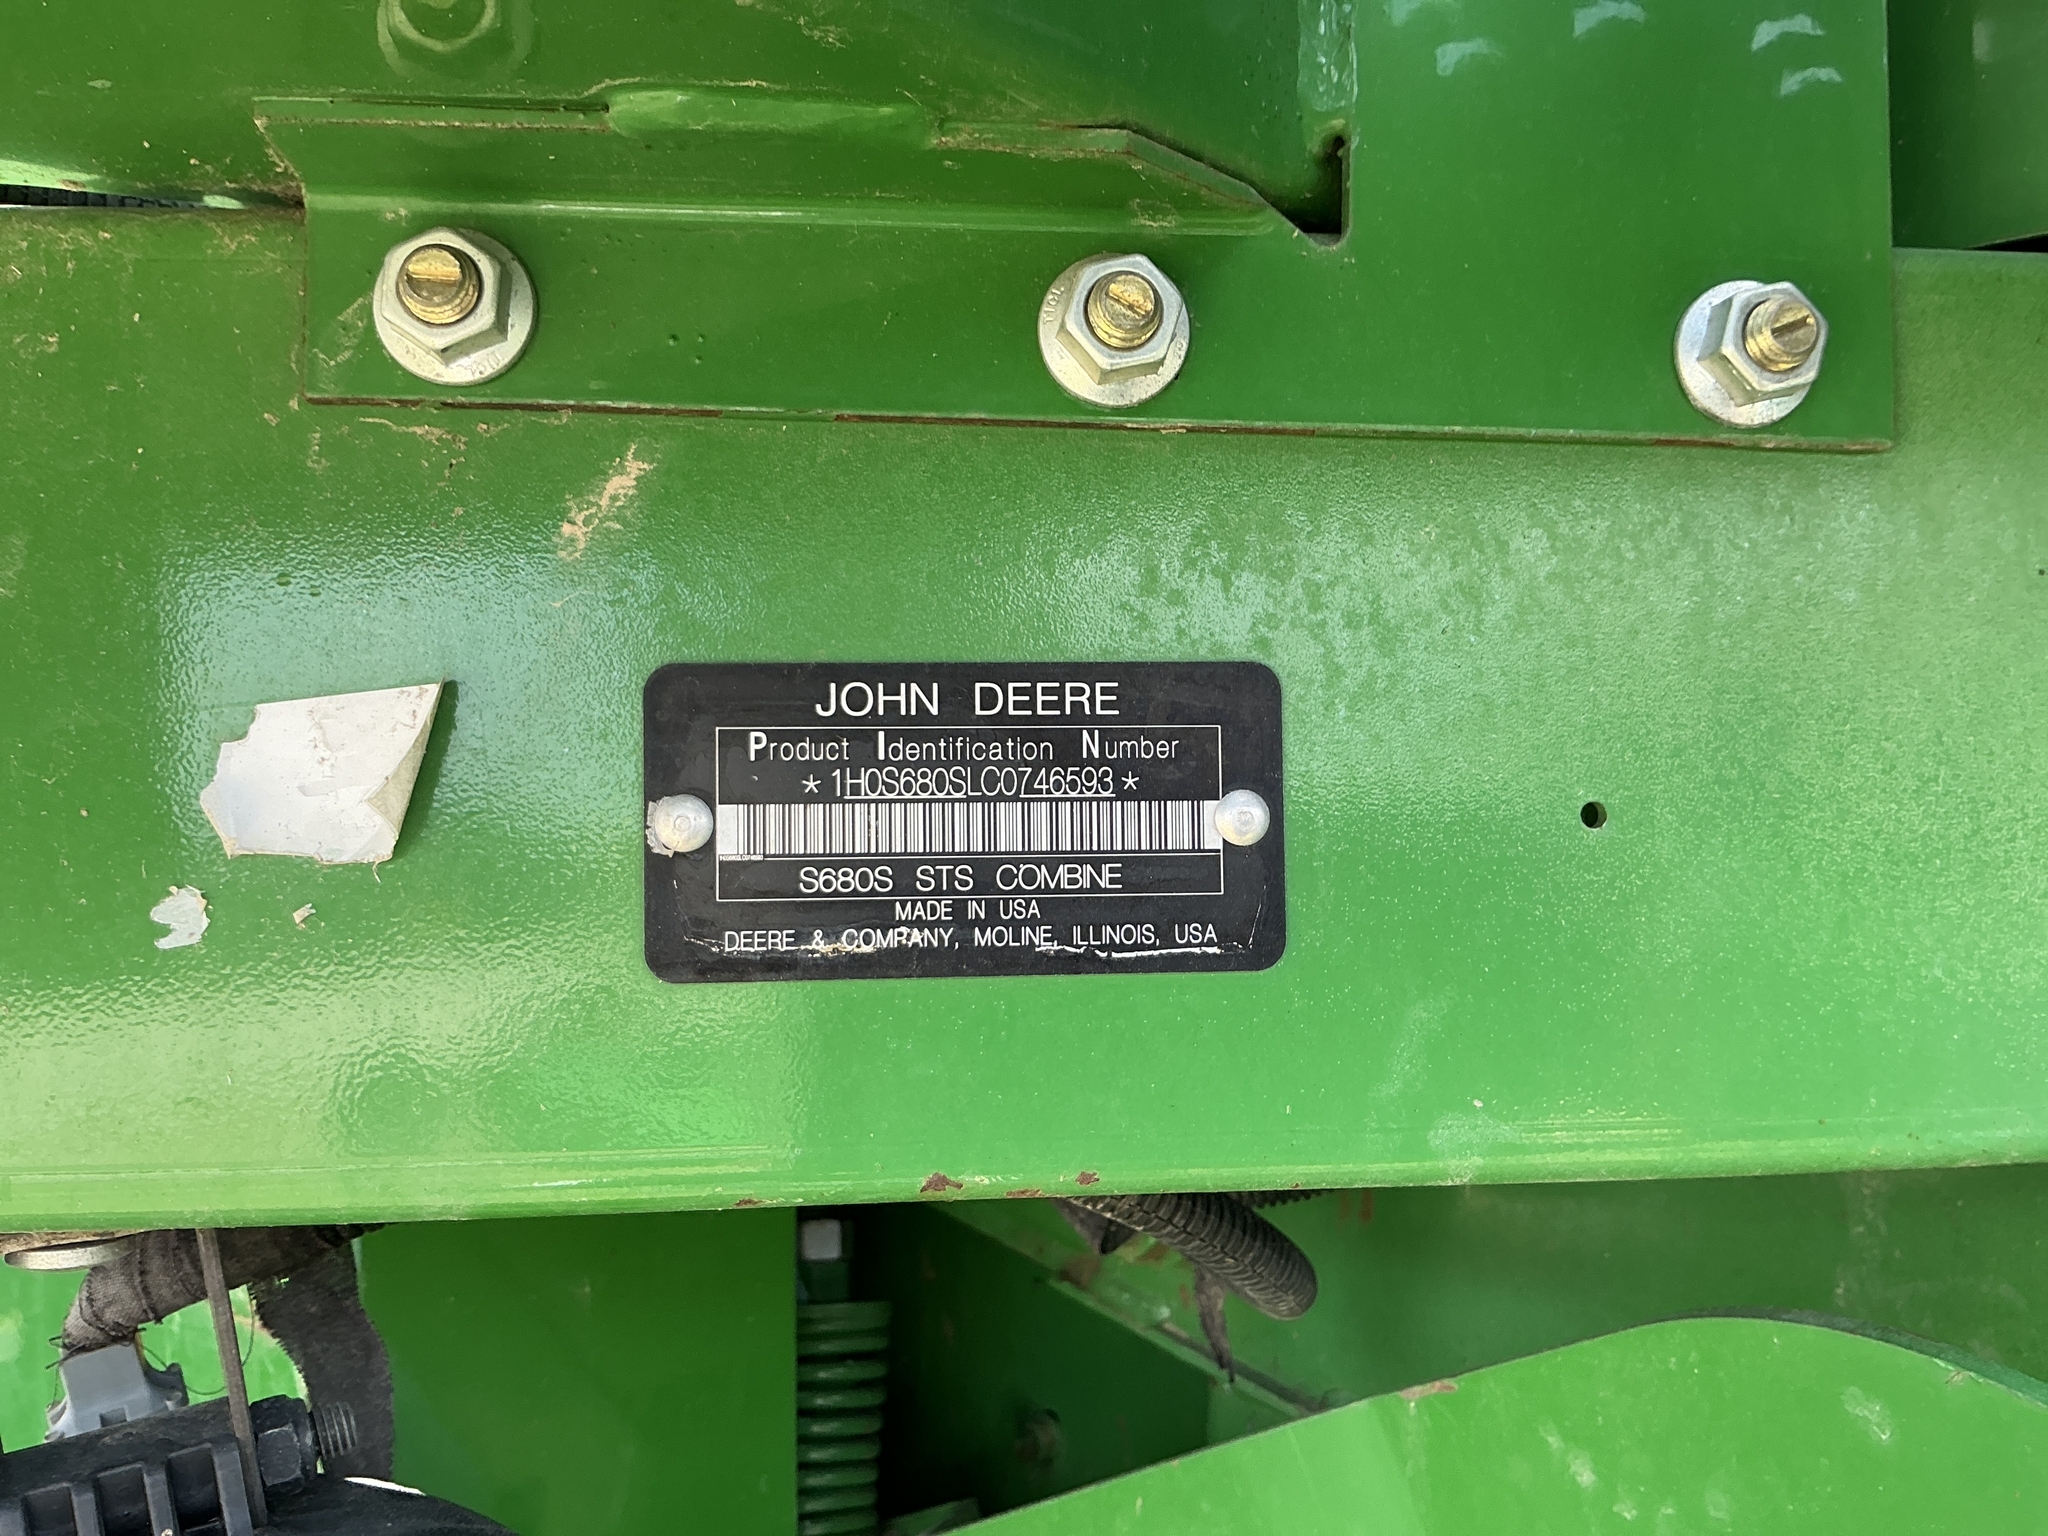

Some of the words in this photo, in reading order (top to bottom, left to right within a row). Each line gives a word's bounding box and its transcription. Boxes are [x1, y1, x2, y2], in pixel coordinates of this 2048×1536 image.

[816, 682, 938, 717] JOHN
[975, 682, 1119, 716] DEERE
[750, 731, 850, 762] Product
[877, 731, 1053, 761] Identification
[1083, 730, 1179, 760] Number
[799, 866, 893, 893] S680S
[916, 865, 974, 892] STS
[996, 864, 1122, 890] COMBINE
[895, 901, 953, 921] MADE
[968, 900, 986, 920] IN
[1000, 899, 1041, 919] USA
[724, 930, 795, 951] DEERE
[813, 929, 827, 949] &
[842, 927, 959, 949] COMPANY,
[974, 926, 1058, 949] MOLINE,
[1073, 924, 1160, 946] ILLINOIS,
[1175, 923, 1217, 944] USA
